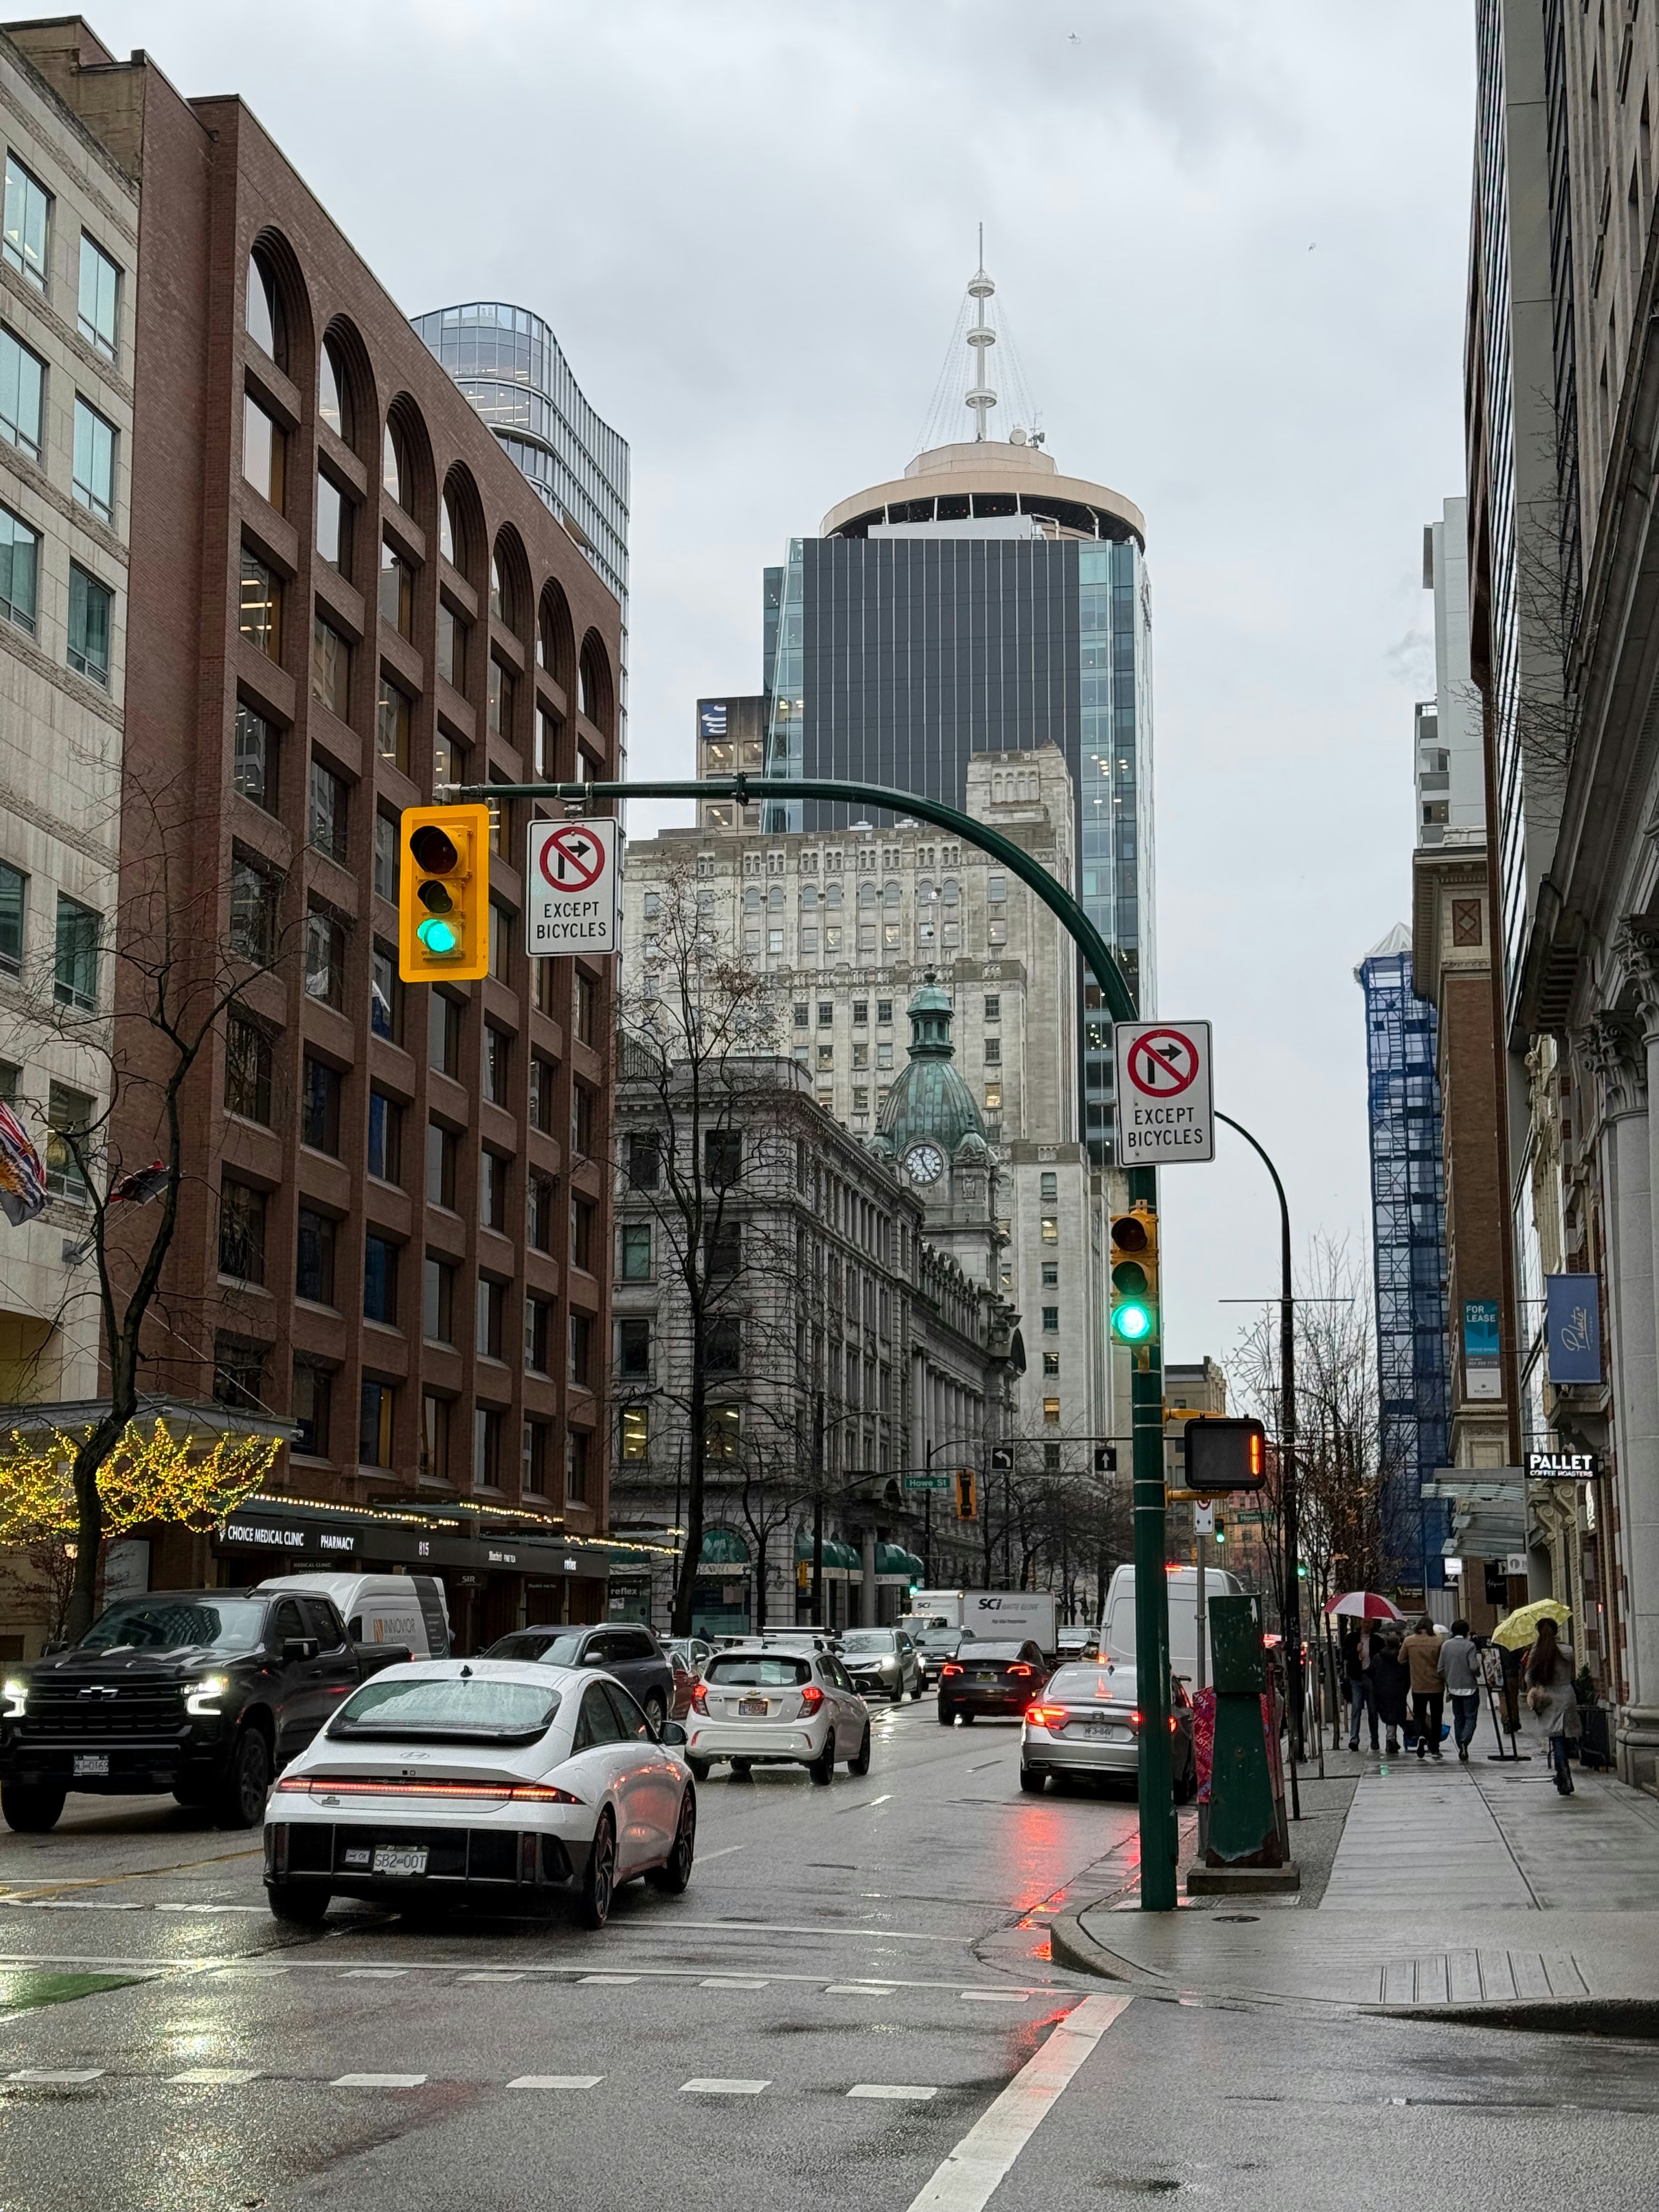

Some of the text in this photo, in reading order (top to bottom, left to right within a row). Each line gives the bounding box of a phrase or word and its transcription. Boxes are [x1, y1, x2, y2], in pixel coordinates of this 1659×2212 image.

[544, 901, 599, 918] EXCEPT
[537, 922, 606, 939] BICYCLES
[1135, 1107, 1195, 1125] EXCEPT
[1128, 1128, 1203, 1148] BICYCLES
[1466, 1305, 1485, 1313] FOR
[1466, 1314, 1497, 1323] LEASE
[1530, 1454, 1593, 1470] PALLET
[228, 1525, 304, 1547] CHOICE MEDICAL CLINIC
[320, 1534, 354, 1551] PHARMACY
[419, 1541, 430, 1556] 815
[610, 1587, 637, 1595] reflex
